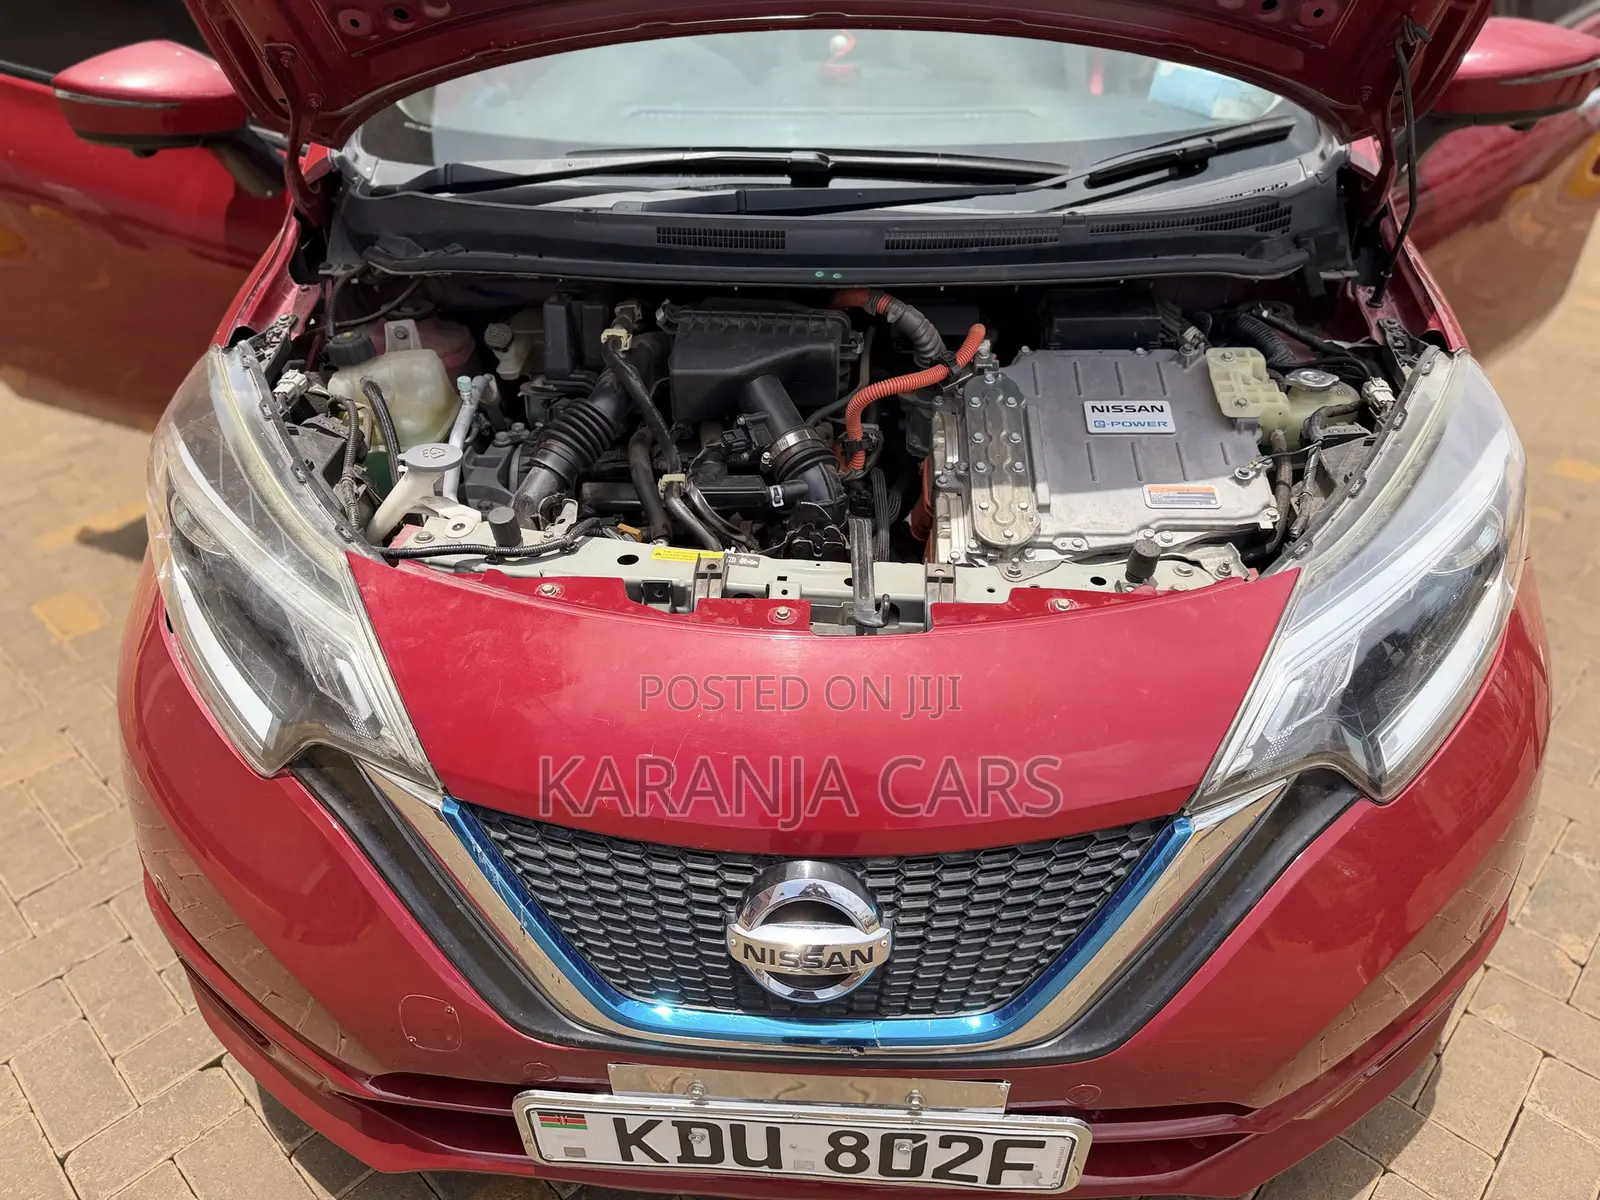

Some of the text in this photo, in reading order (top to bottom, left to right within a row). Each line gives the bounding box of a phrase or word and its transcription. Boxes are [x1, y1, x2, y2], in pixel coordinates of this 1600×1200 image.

[1091, 405, 1164, 413] NISSAN
[743, 942, 873, 969] NISSAN
[612, 1117, 783, 1170] KDU
[824, 1130, 1047, 1185] 802F
